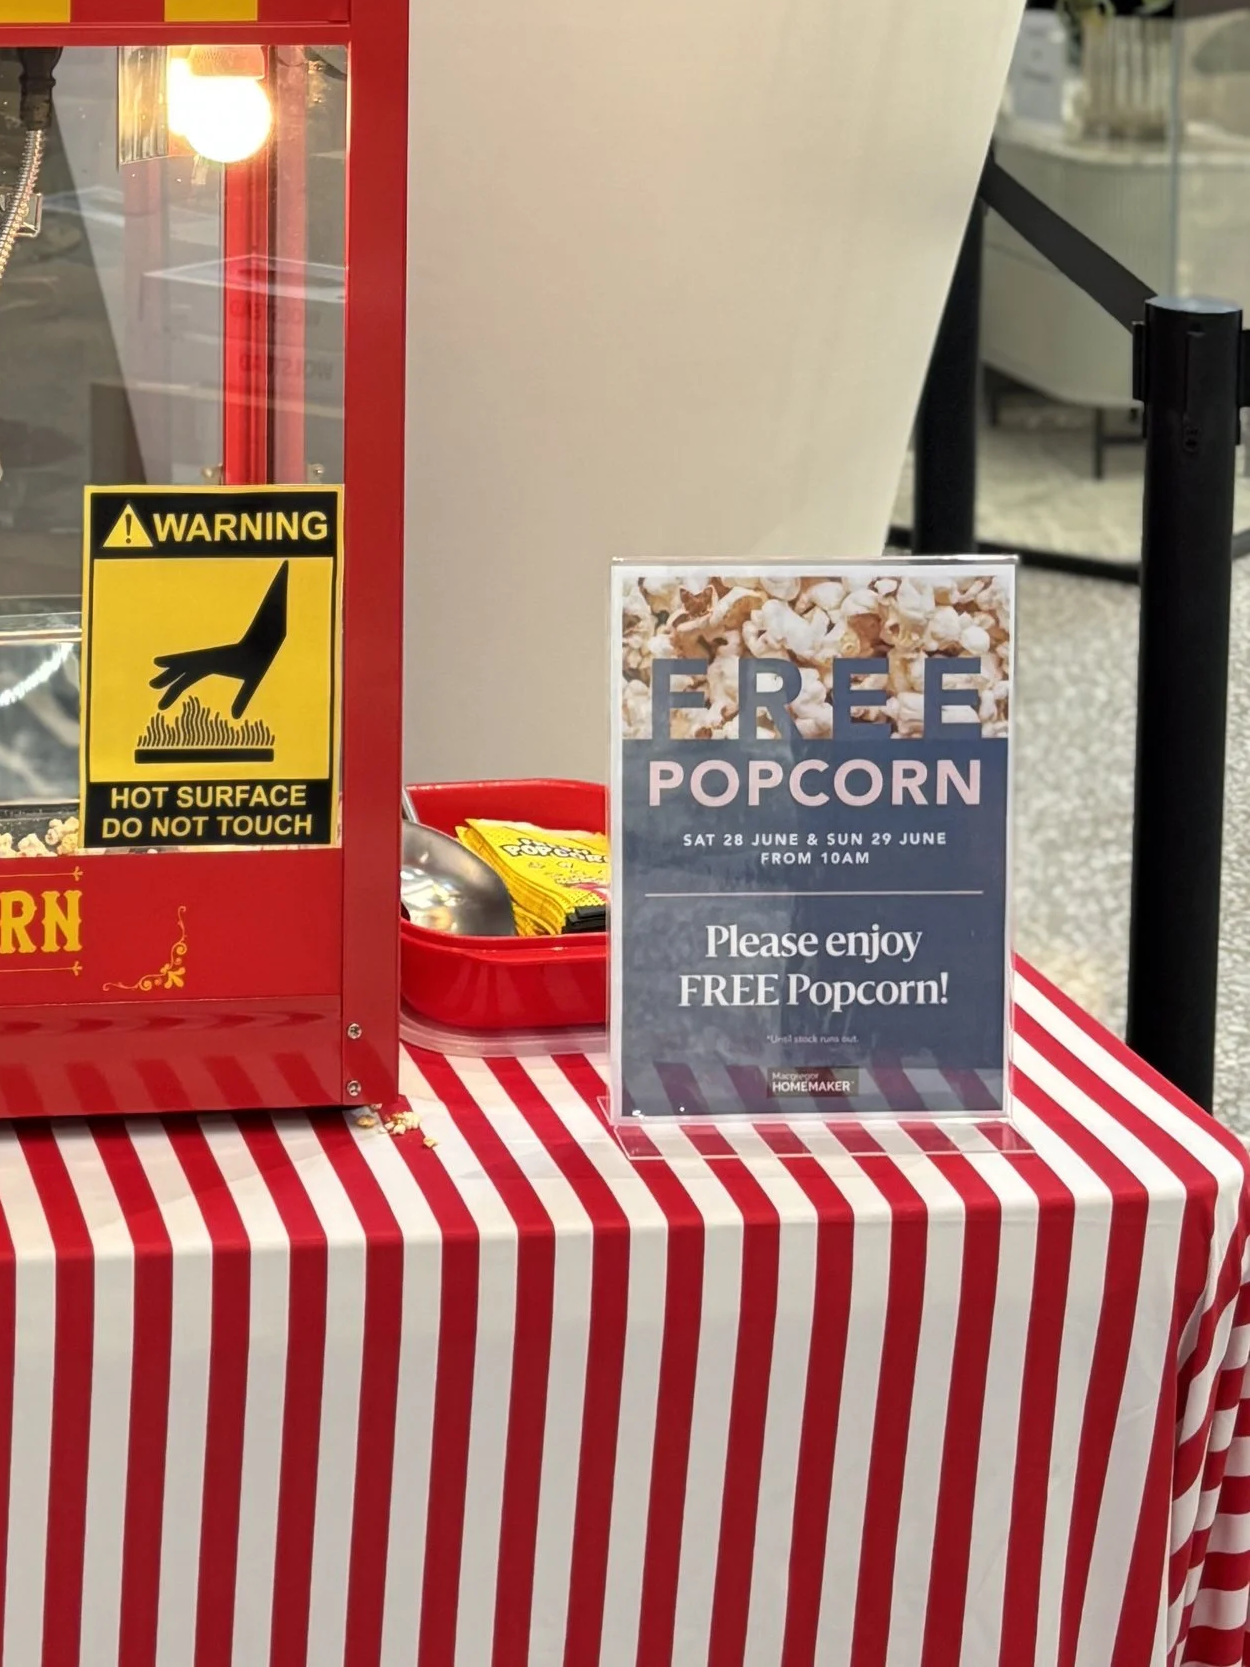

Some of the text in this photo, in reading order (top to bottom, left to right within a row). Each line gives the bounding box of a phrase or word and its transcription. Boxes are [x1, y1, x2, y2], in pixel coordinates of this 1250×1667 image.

[153, 511, 328, 542] WARNING
[652, 658, 981, 740] FREE
[111, 785, 307, 809] HOT SURFACE
[649, 759, 981, 807] POPCORN
[102, 814, 313, 839] DO NOT TOUCH
[683, 832, 946, 846] SAT 28 JUNE & SUN 29 JUNE
[761, 852, 870, 865] FROM 10AM
[705, 924, 922, 963] Please enjoy
[678, 972, 949, 1013] FREE Popcorn!
[794, 1034, 817, 1043] stock
[820, 1035, 839, 1043] runs
